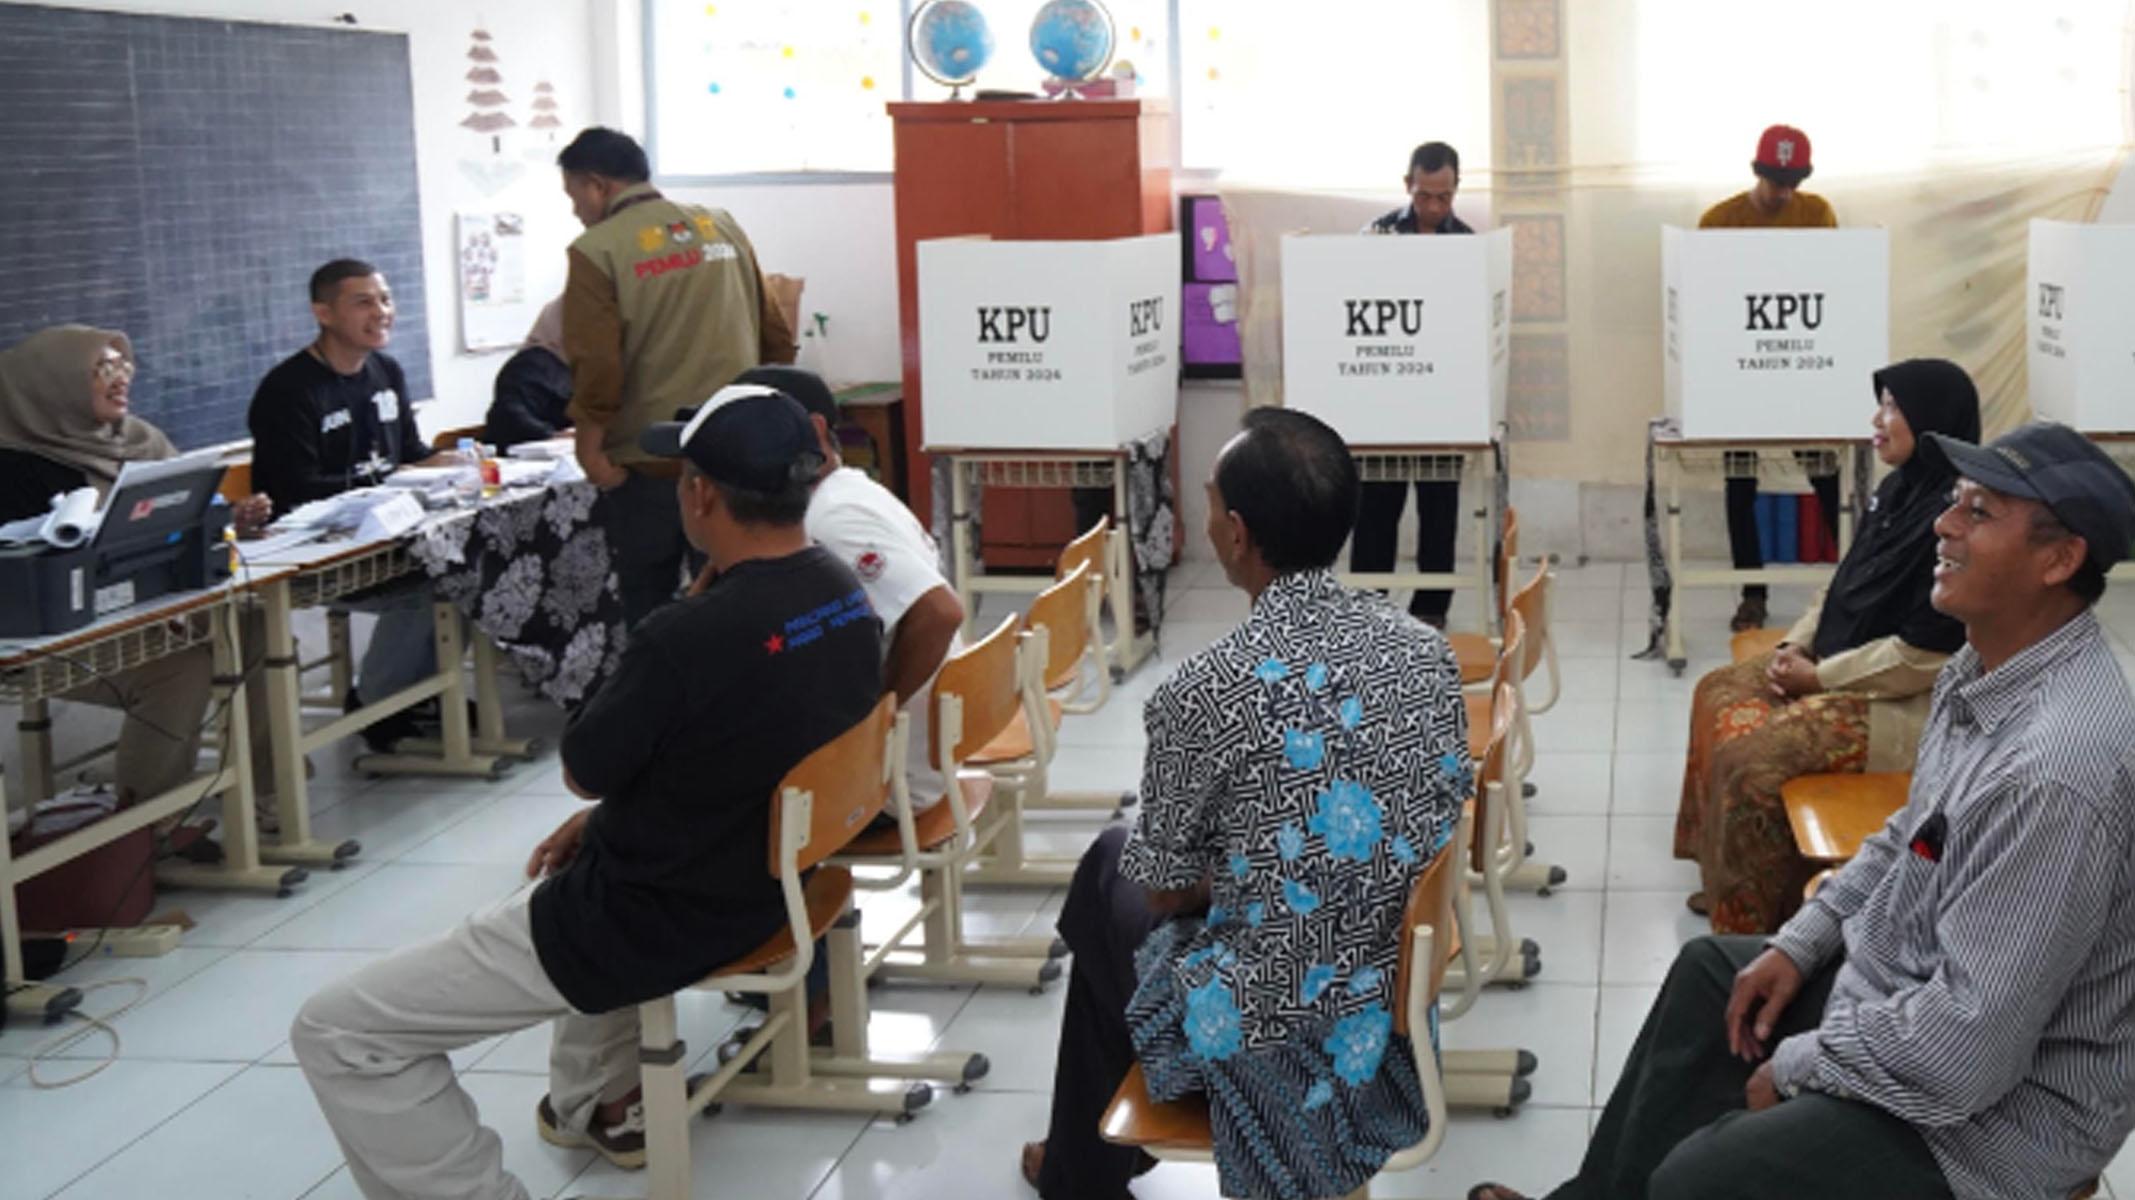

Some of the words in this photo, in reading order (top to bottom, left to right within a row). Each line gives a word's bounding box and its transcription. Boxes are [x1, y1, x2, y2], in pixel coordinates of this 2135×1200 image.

[1130, 296, 1164, 337] KPU
[1345, 299, 1424, 336] KPU
[1745, 293, 1824, 330] KPU
[977, 306, 1051, 342] KPU
[1356, 345, 1414, 357] PEMILU
[1755, 338, 1814, 352] PEMILU
[988, 352, 1043, 364] PEMILU
[1737, 358, 1790, 370] TAHUN
[1796, 356, 1834, 369] 2024
[971, 368, 1021, 381] TAHUN
[1026, 368, 1062, 381] 2024
[1338, 362, 1391, 375] TAHUN
[1397, 362, 1434, 375] 2024
